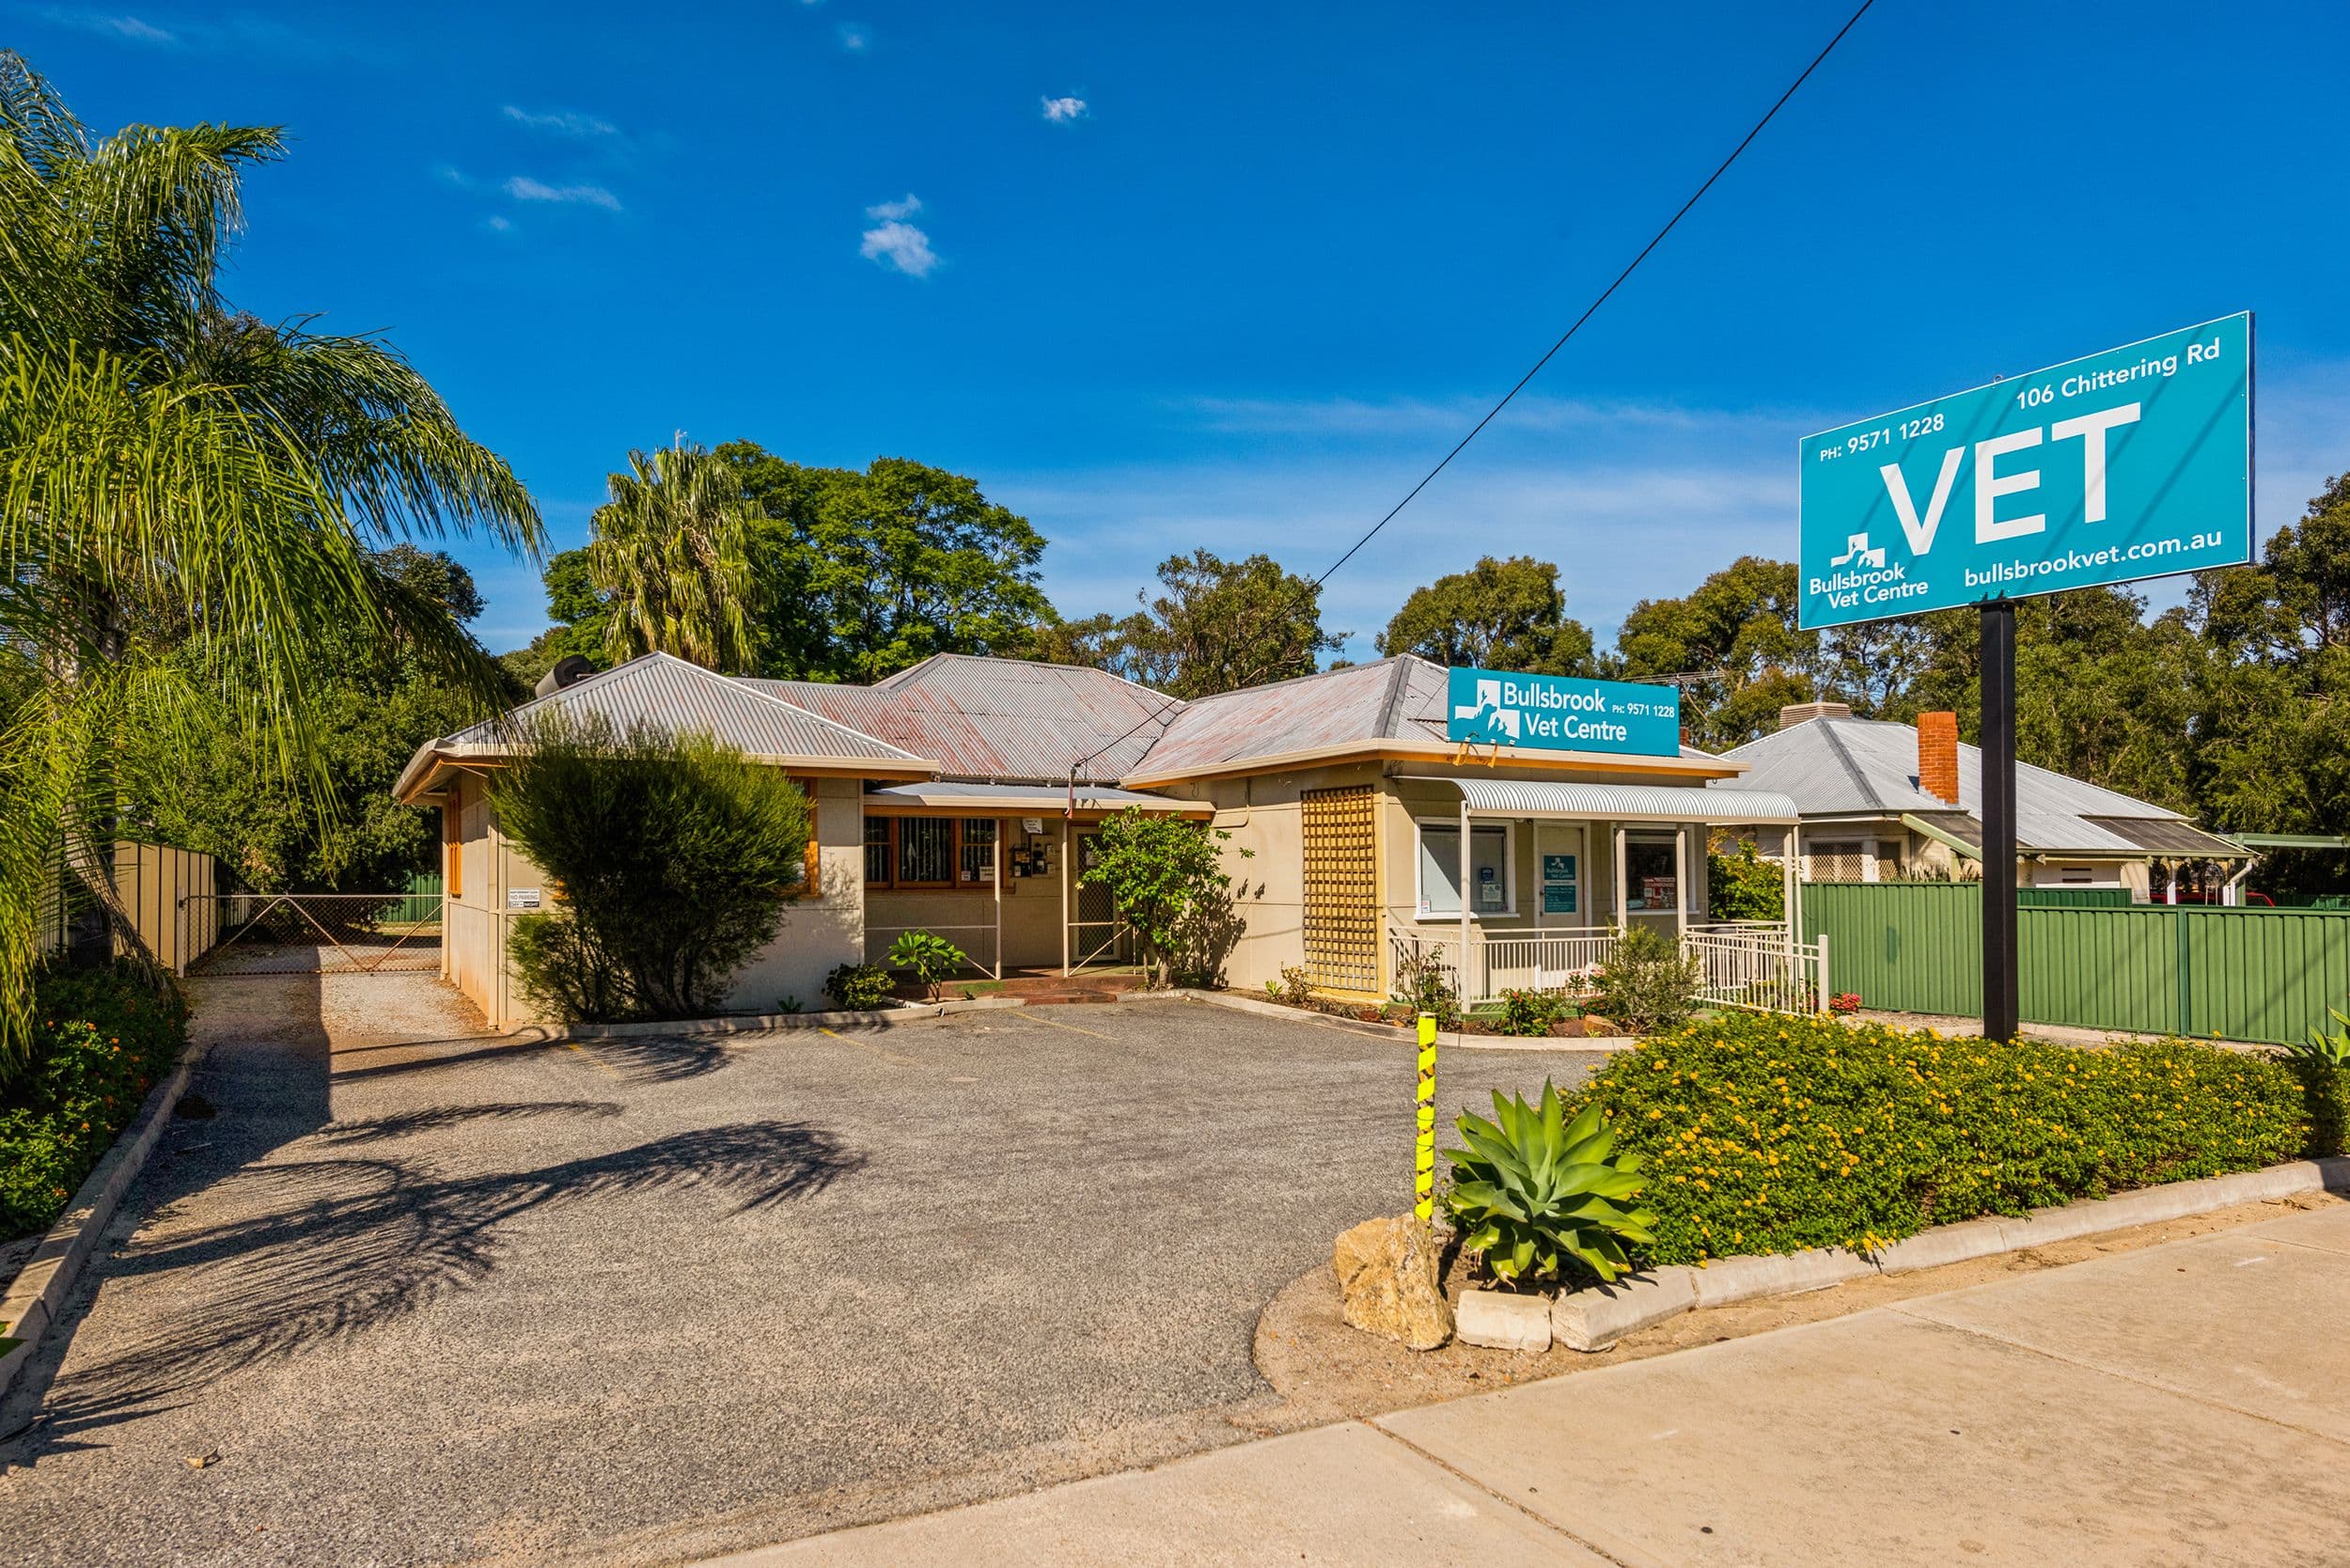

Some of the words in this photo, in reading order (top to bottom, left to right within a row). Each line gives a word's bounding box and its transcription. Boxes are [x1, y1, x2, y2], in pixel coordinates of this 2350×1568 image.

[2016, 384, 2054, 410] 106
[2061, 354, 2177, 398] Chittering
[2187, 337, 2220, 365] Rd
[1820, 445, 1842, 462] PH:
[1847, 429, 1890, 454] 9571
[1899, 414, 1945, 440] 1228
[1880, 401, 2141, 557] VET
[1810, 563, 1905, 595] Bullsbrook
[1965, 531, 2222, 588] bullsbrookvet.com.au
[1827, 588, 1871, 609] Vet
[1874, 580, 1929, 603] Centre
[1504, 682, 1606, 713] Bullsbrook
[1612, 704, 1624, 713] PH:
[1627, 703, 1649, 715] 9571
[1653, 705, 1675, 718] 1228
[1525, 713, 1559, 738] Vet
[1563, 715, 1627, 742] Centre
